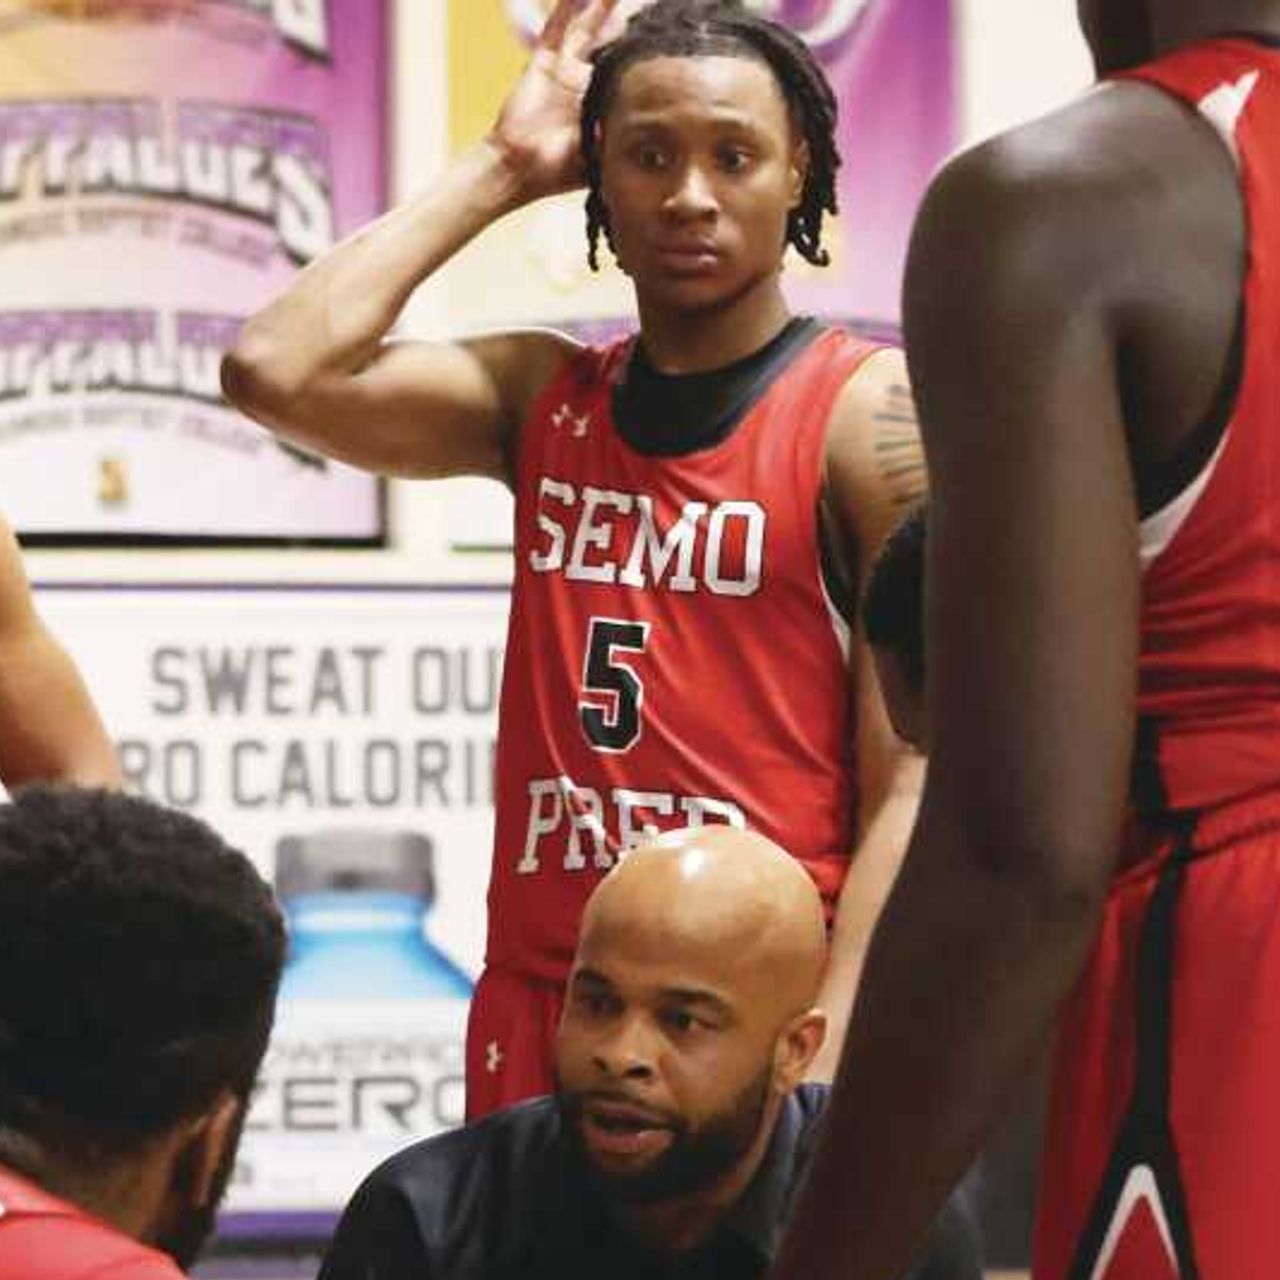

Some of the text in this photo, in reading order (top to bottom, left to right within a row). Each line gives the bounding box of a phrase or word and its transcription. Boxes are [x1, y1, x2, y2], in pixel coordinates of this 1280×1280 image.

[528, 477, 766, 597] SEMO
[151, 646, 500, 716] SWEAT OU
[577, 616, 652, 754] 5
[119, 738, 496, 809] RO CALORI
